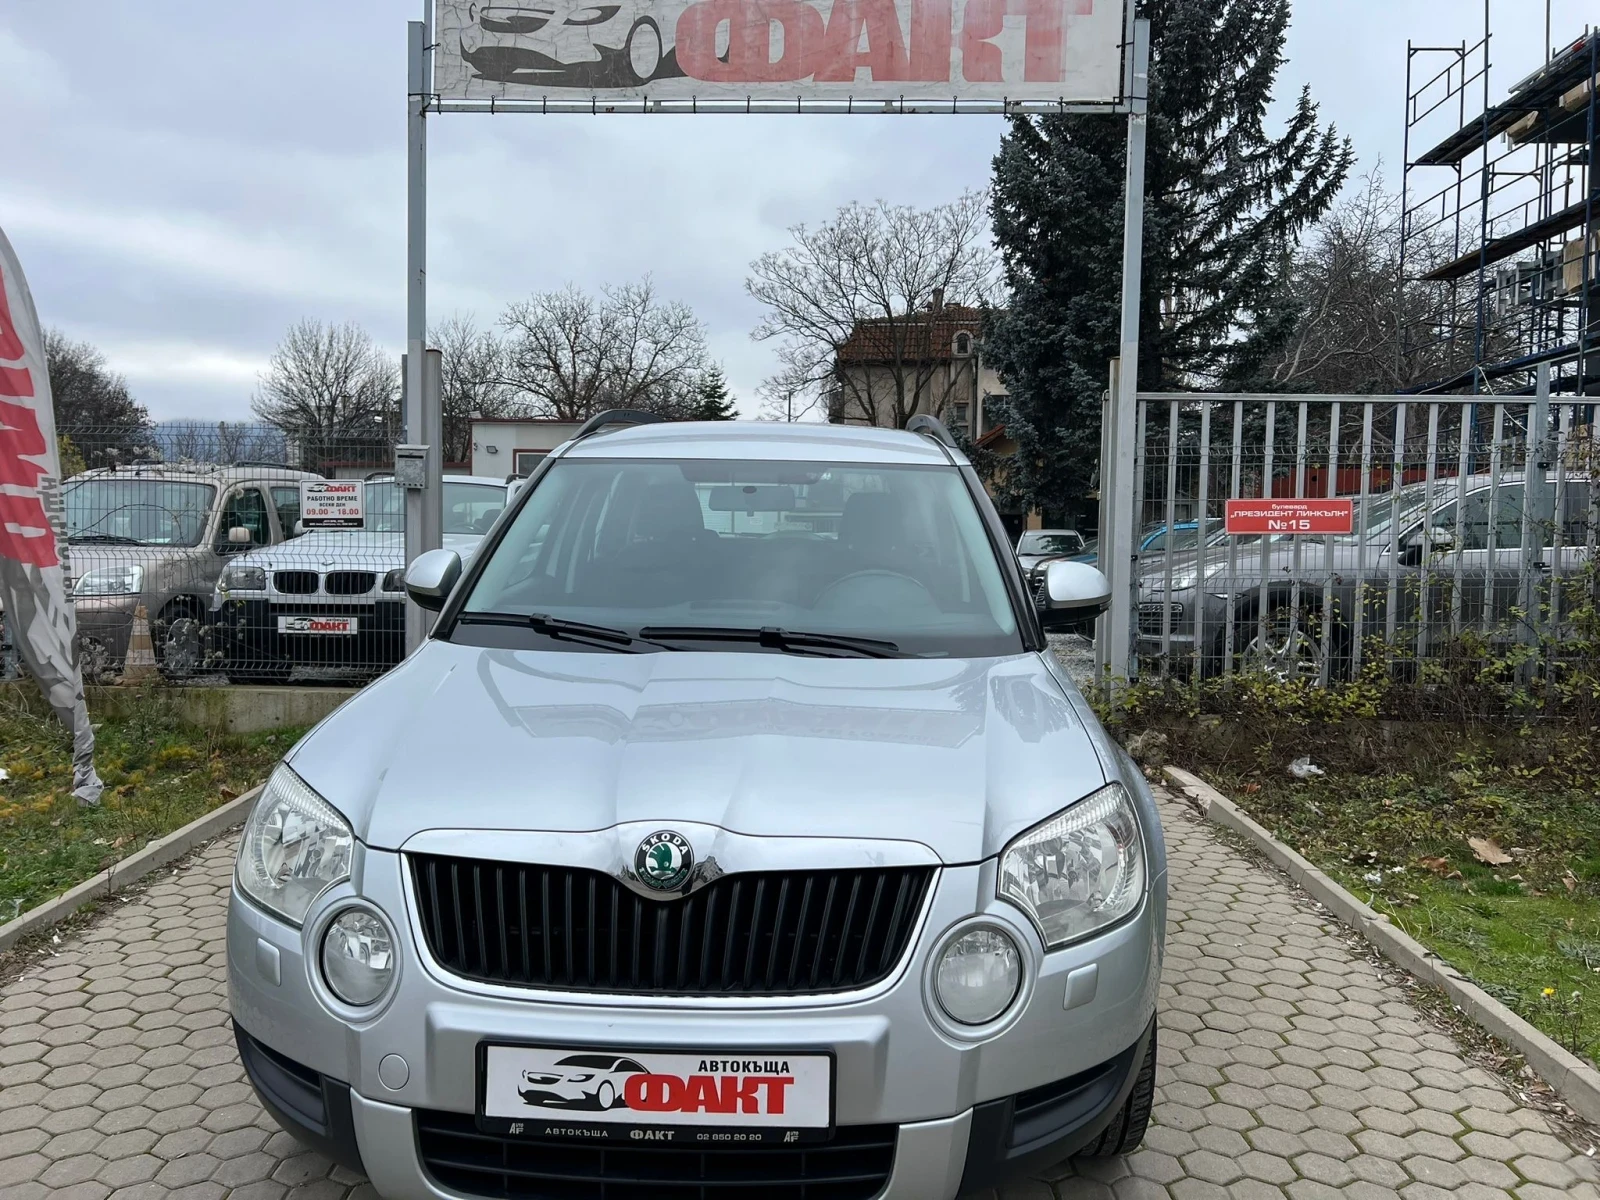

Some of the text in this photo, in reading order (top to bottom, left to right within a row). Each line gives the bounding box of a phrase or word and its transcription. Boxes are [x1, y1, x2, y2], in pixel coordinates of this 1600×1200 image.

[675, 0, 1093, 82] ФАКТ
[1271, 503, 1308, 511] булевард
[310, 622, 349, 631] ФАКТ
[697, 1060, 791, 1076] АВТОКЪЩА
[624, 1073, 795, 1115] ФАКТ
[629, 1129, 675, 1140] ФАКТ
[696, 1133, 710, 1141] 02
[733, 1133, 747, 1141] 20
[748, 1133, 762, 1141] 20
